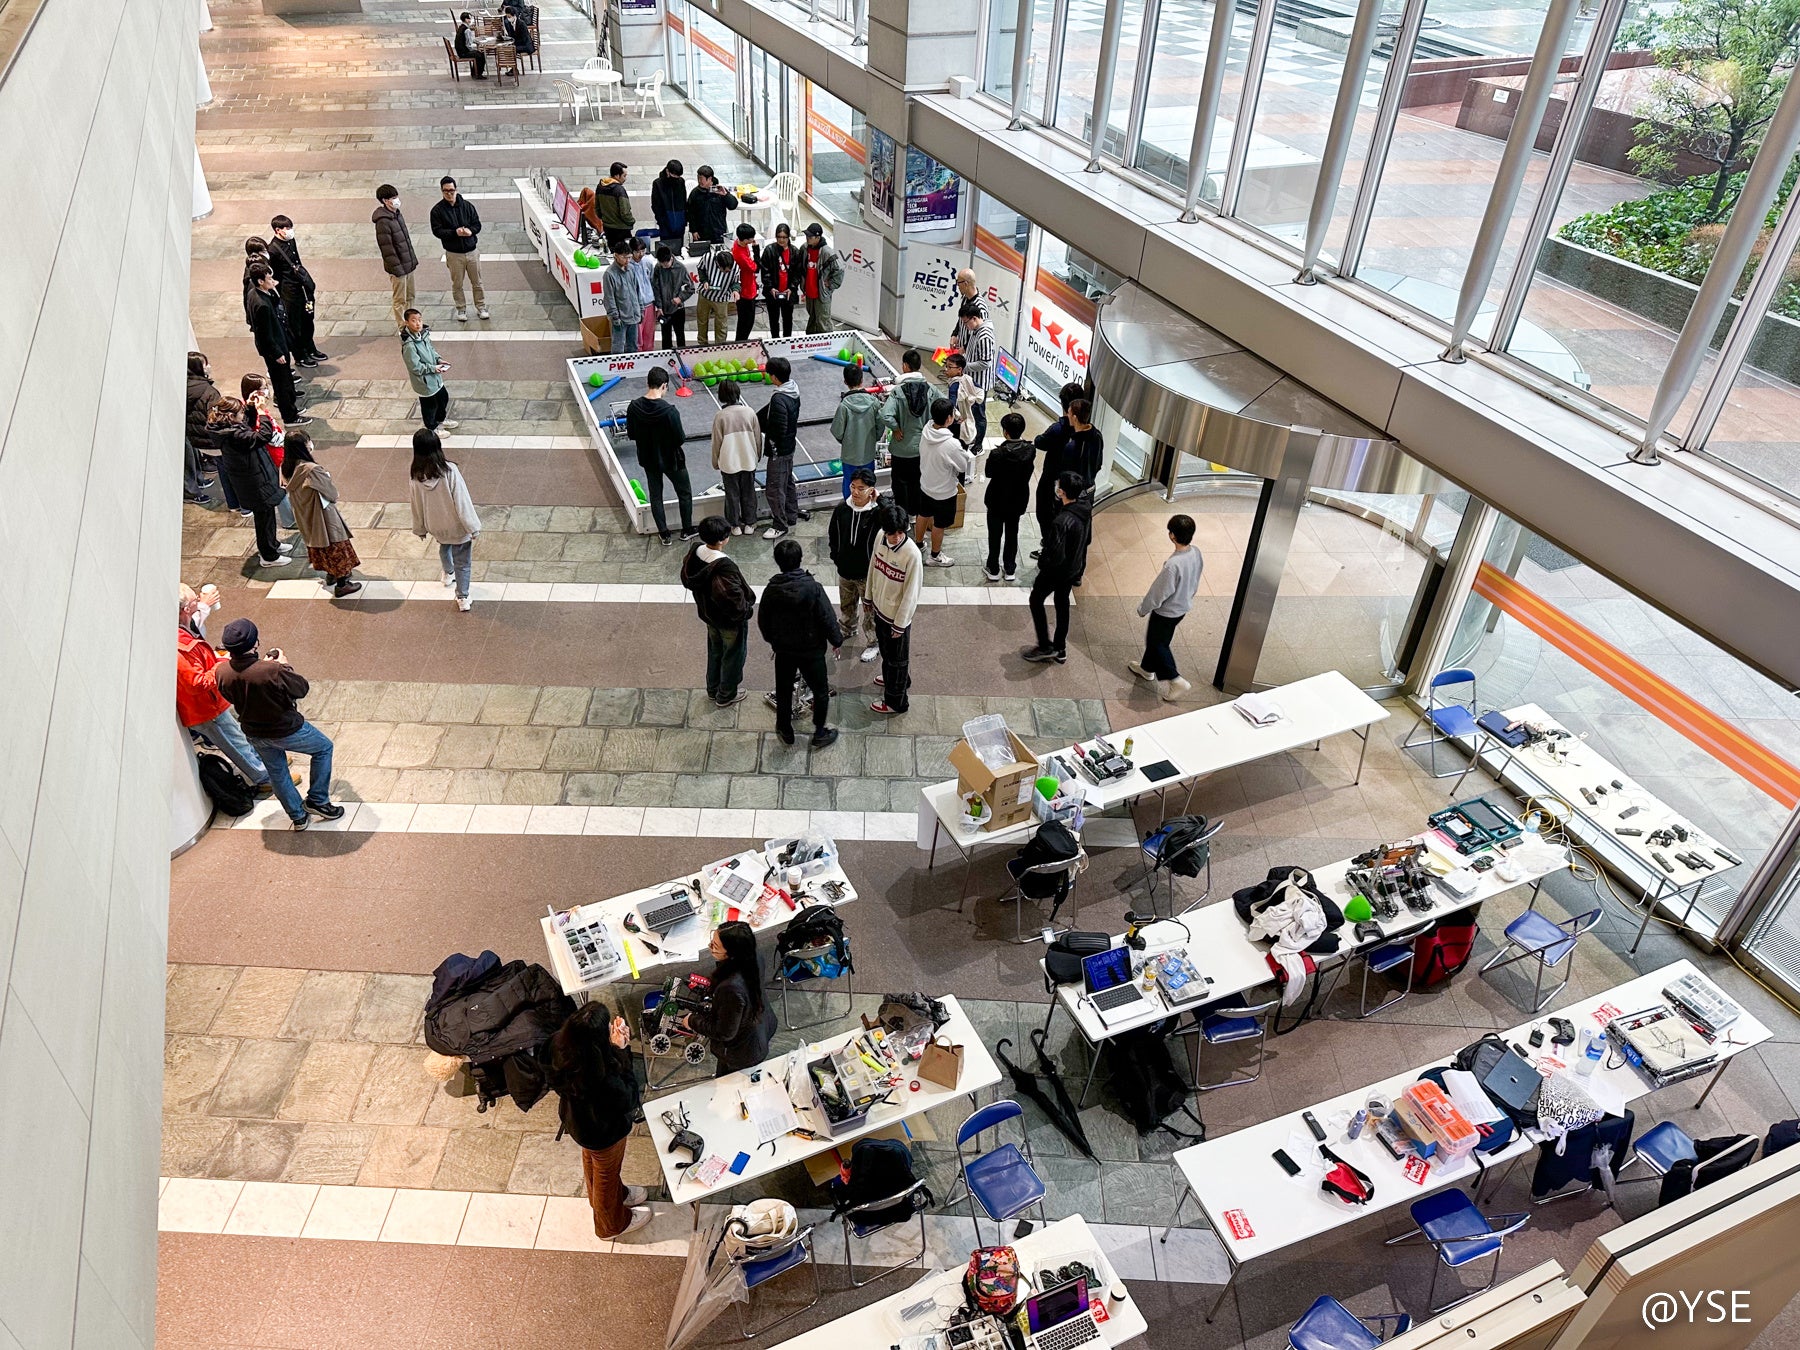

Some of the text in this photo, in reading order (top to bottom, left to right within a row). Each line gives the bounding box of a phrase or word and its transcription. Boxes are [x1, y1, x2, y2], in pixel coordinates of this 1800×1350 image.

[838, 248, 875, 272] VEX
[911, 283, 947, 295] FOUNDATION
[913, 271, 949, 289] REC
[804, 340, 832, 348] Kawasaki
[1066, 333, 1090, 368] Ka
[609, 361, 635, 371] PWR
[1028, 335, 1070, 379] Powering
